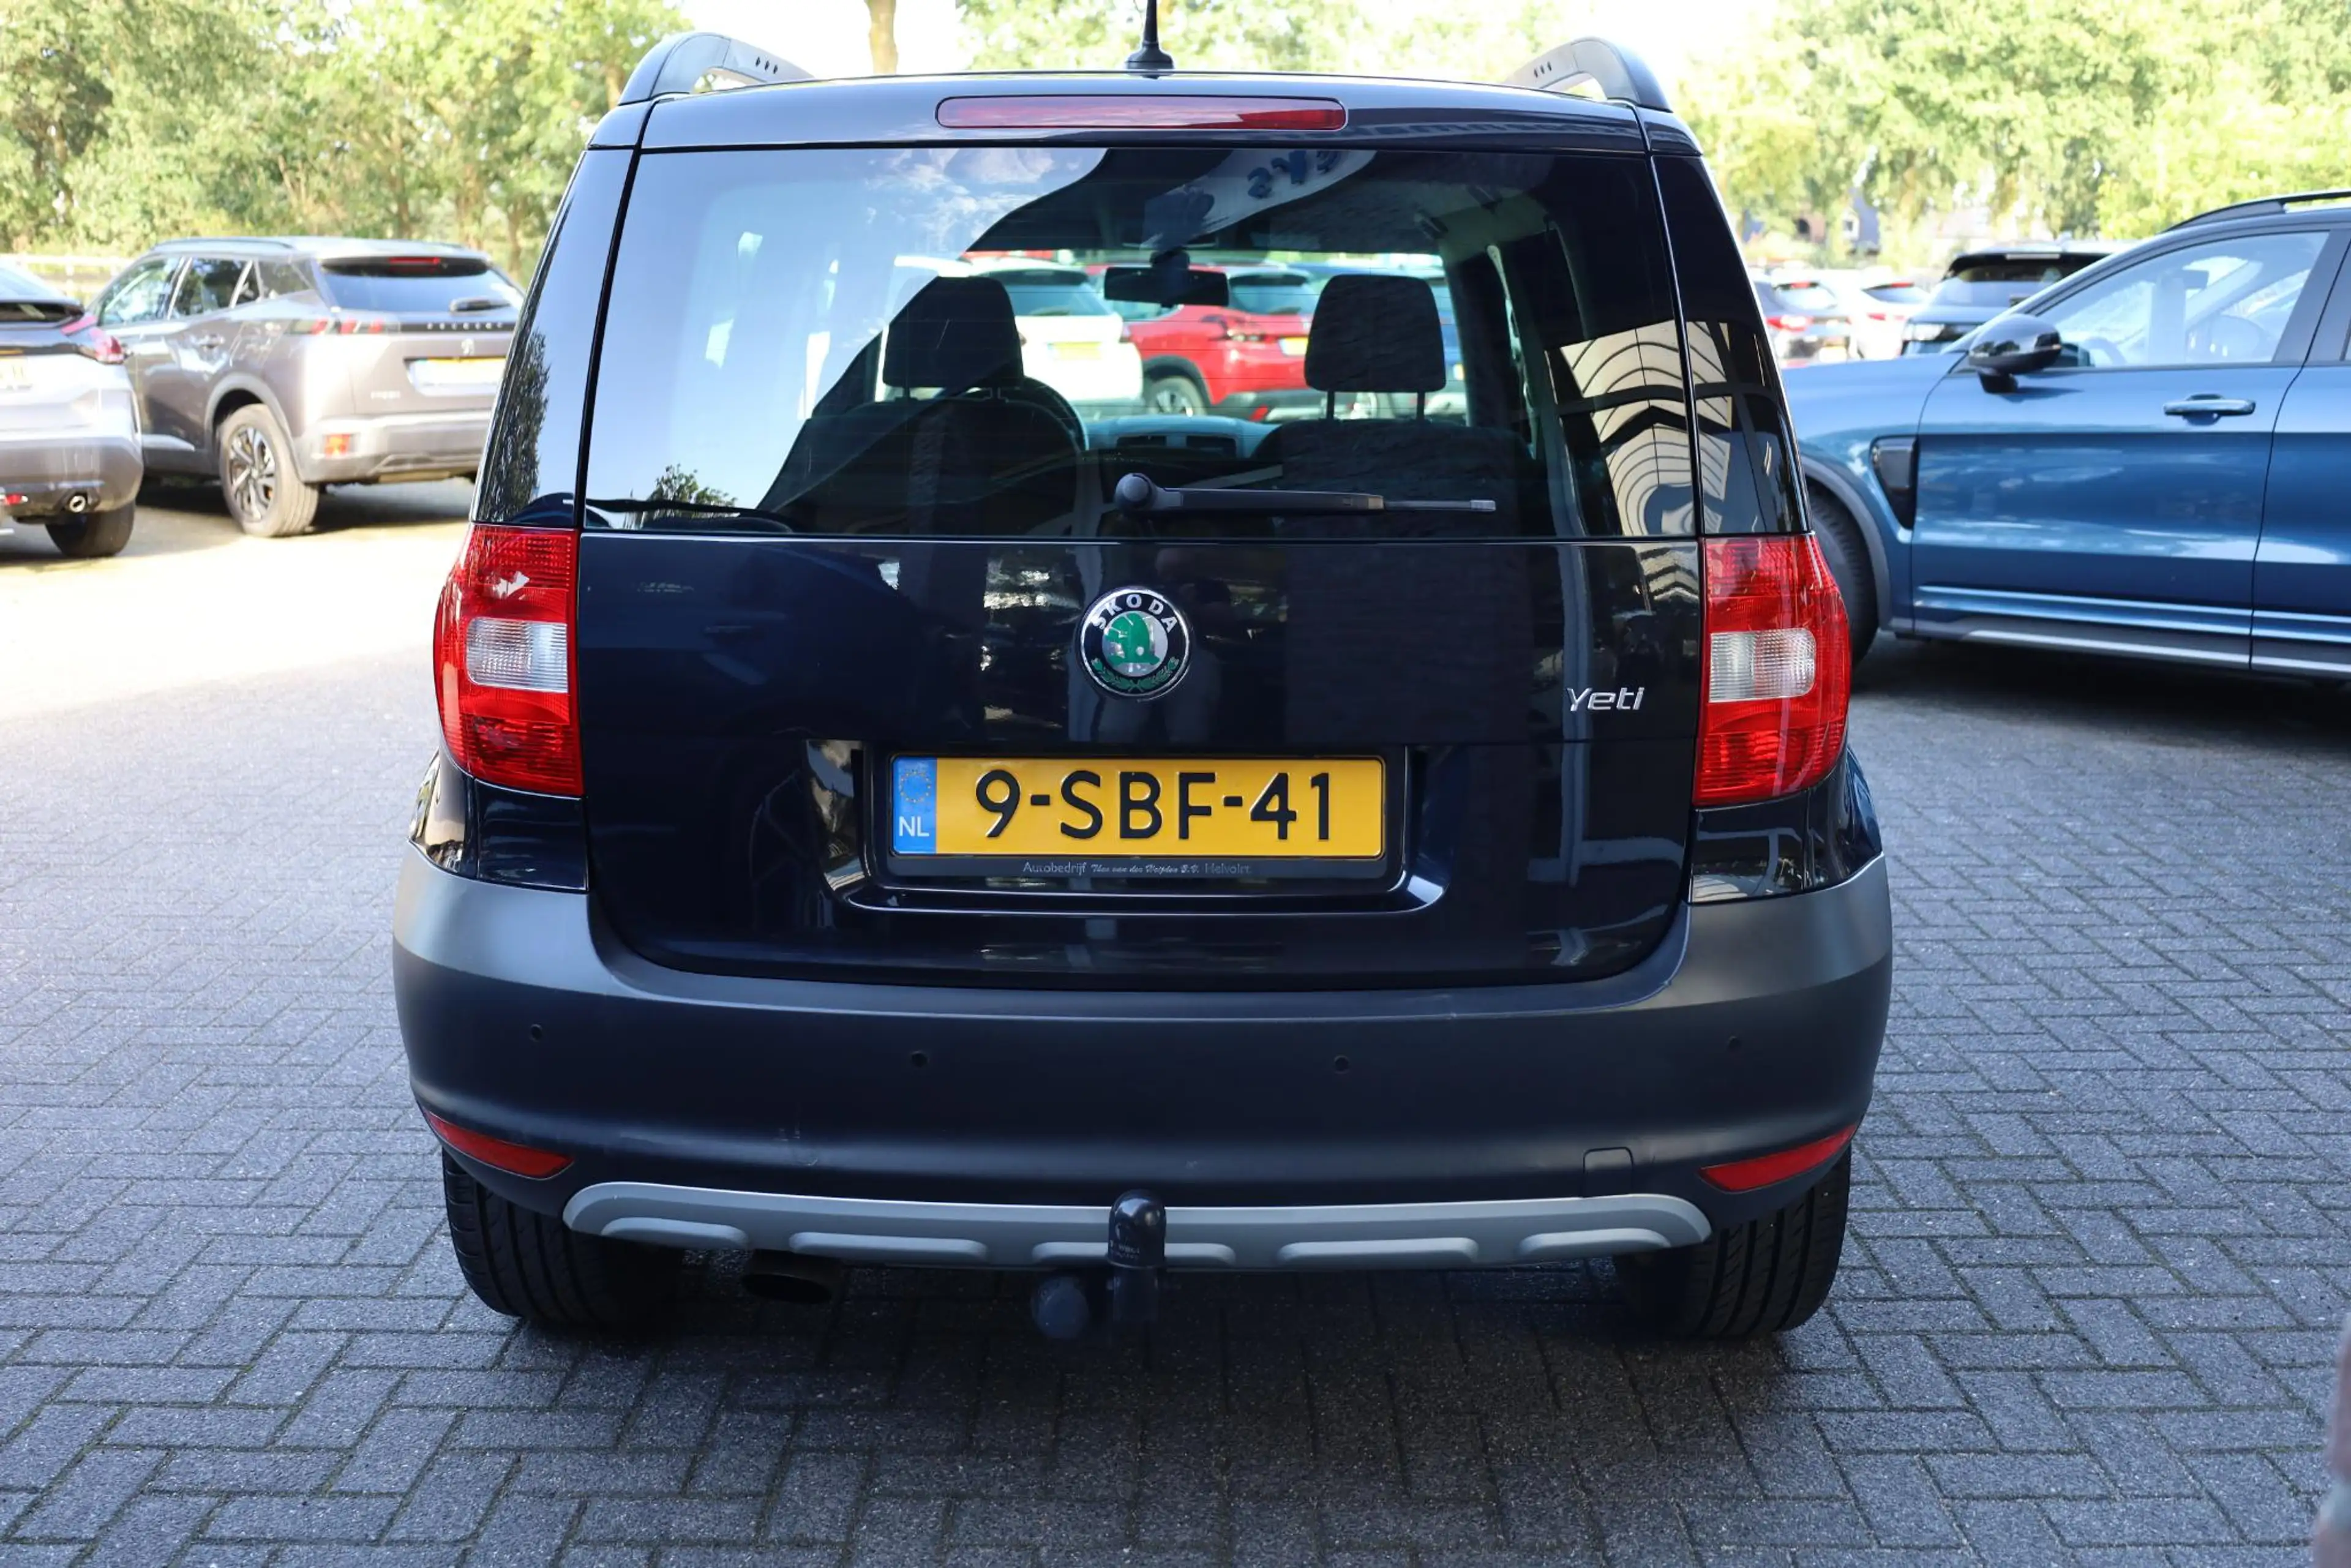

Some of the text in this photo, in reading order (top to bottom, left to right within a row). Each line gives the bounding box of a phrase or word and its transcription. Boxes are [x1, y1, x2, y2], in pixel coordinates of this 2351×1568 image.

[1567, 686, 1645, 711] Yeti
[975, 769, 1330, 841] 9-SBF-41
[899, 816, 929, 837] NL
[1022, 861, 1087, 876] Autobedrijf
